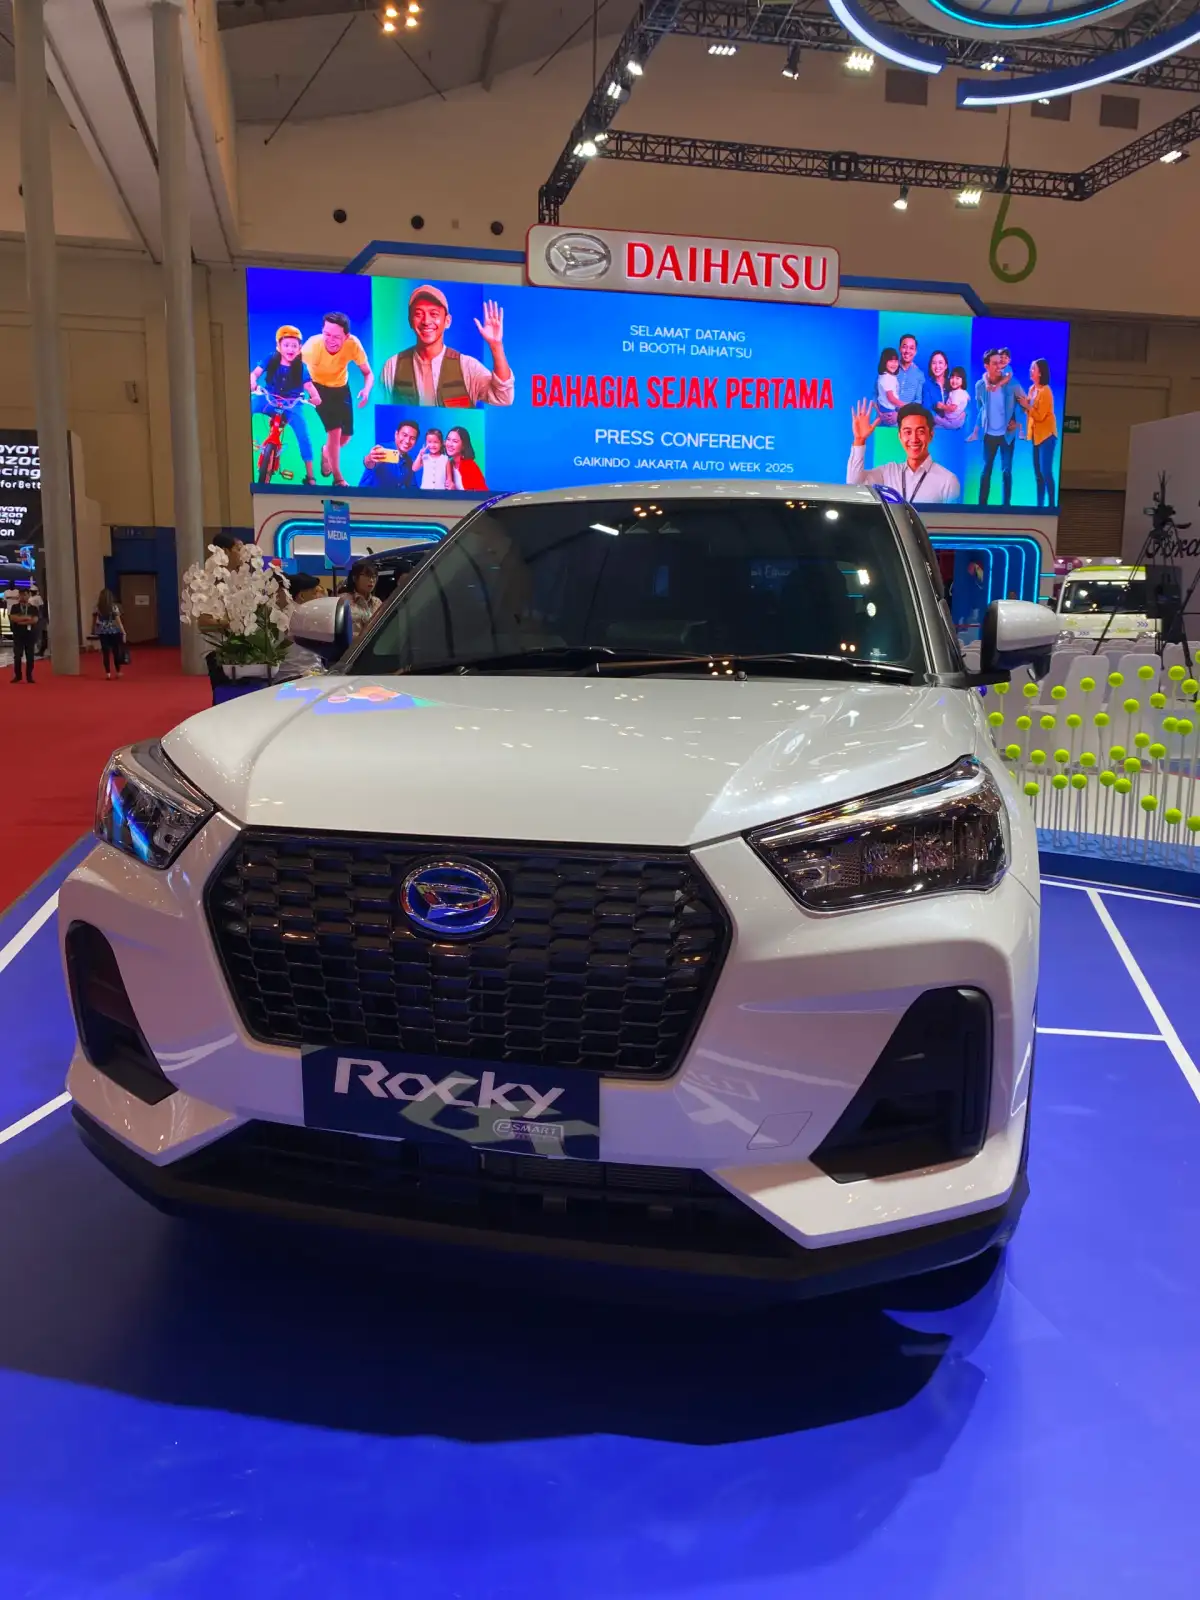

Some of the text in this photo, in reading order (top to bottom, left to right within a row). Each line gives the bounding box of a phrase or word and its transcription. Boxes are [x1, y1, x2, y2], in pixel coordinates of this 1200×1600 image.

[989, 193, 1037, 283] 6
[627, 242, 828, 291] DAIHATSU
[630, 325, 746, 342] SELAMAT DATANG
[622, 340, 752, 359] DI BOOTH DAIHATSU
[531, 373, 835, 410] BAHAGIA SEJAK PERTAMA
[595, 428, 775, 450] PRESS CONFERENCE
[573, 456, 794, 473] GAIKINDO JAKARTA AUTO WEEK 2025
[327, 530, 348, 541] MEDIA
[334, 1057, 566, 1119] Rocky
